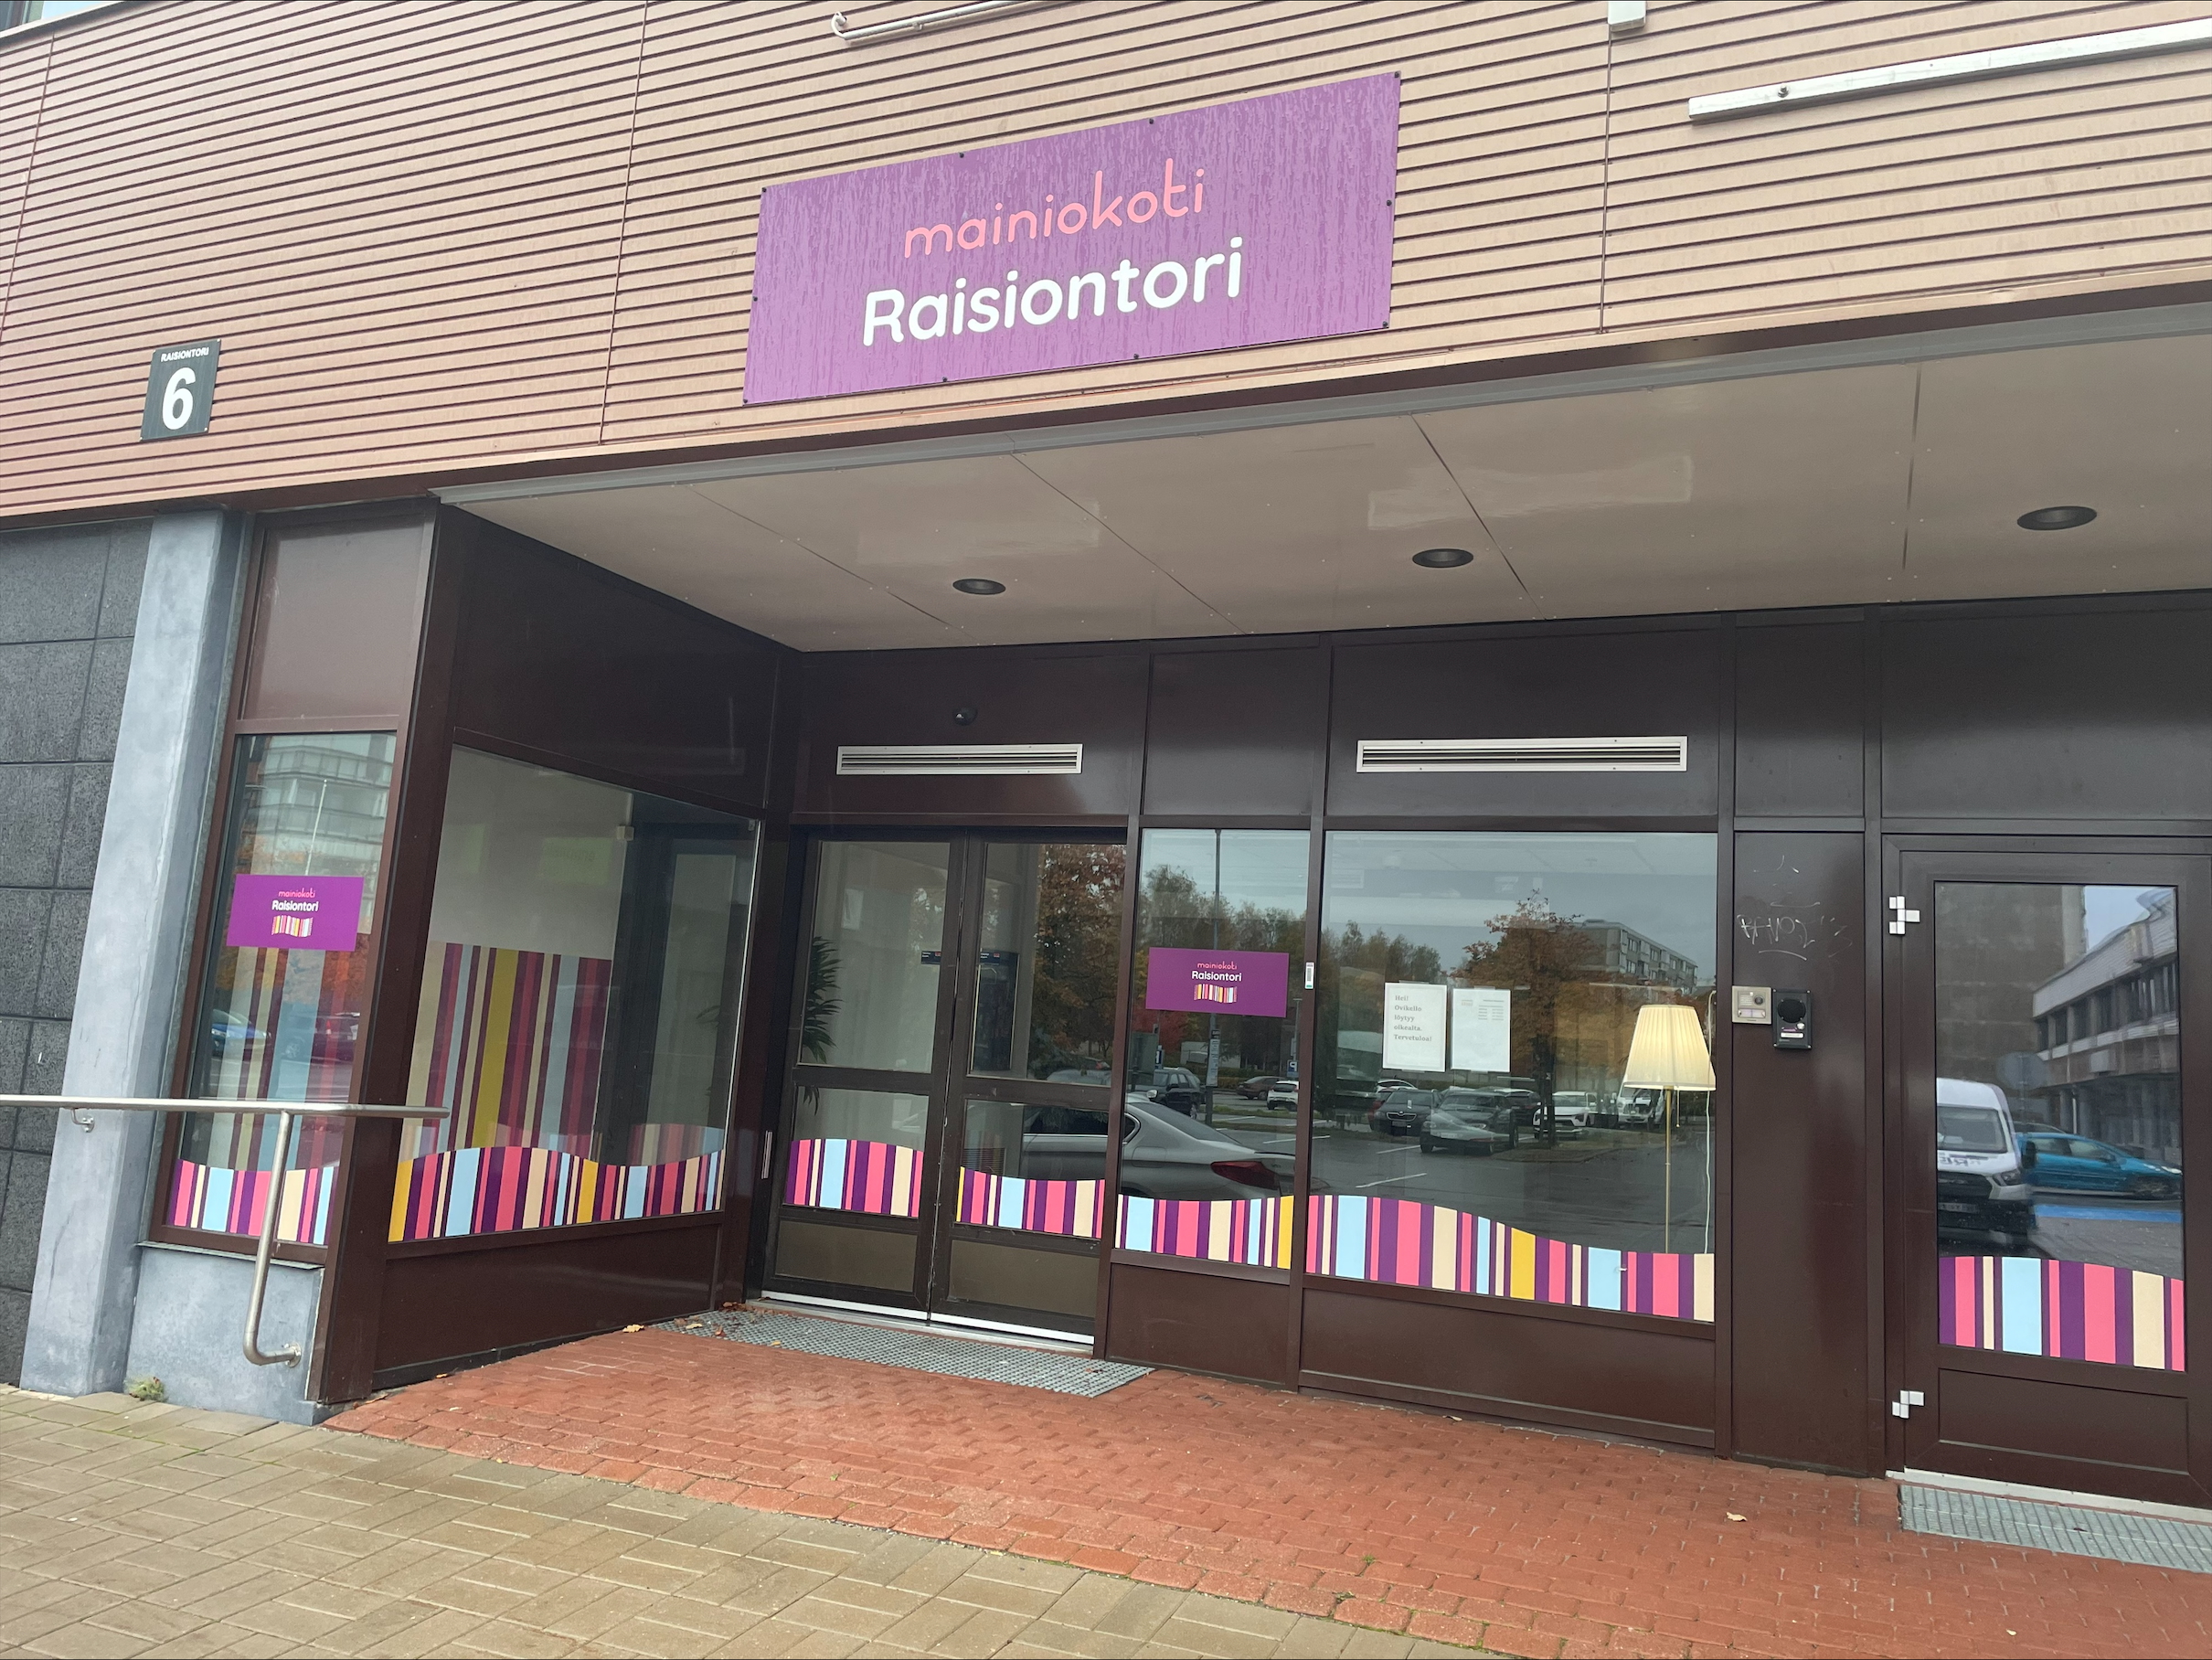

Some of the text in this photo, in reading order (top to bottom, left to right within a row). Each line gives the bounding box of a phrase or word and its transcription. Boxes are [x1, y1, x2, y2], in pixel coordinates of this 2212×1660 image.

[904, 158, 1205, 259] mainiokoti
[863, 236, 1243, 347] Raisiontori
[161, 347, 209, 362] RAISIONTORI
[162, 367, 197, 431] 6
[278, 888, 316, 899] mainiokoti
[271, 899, 320, 912] Raisiontori
[1196, 961, 1238, 971] mainiokoti
[1191, 970, 1242, 982] Raisiontori
[1393, 1034, 1432, 1042] Tervetuloa!
